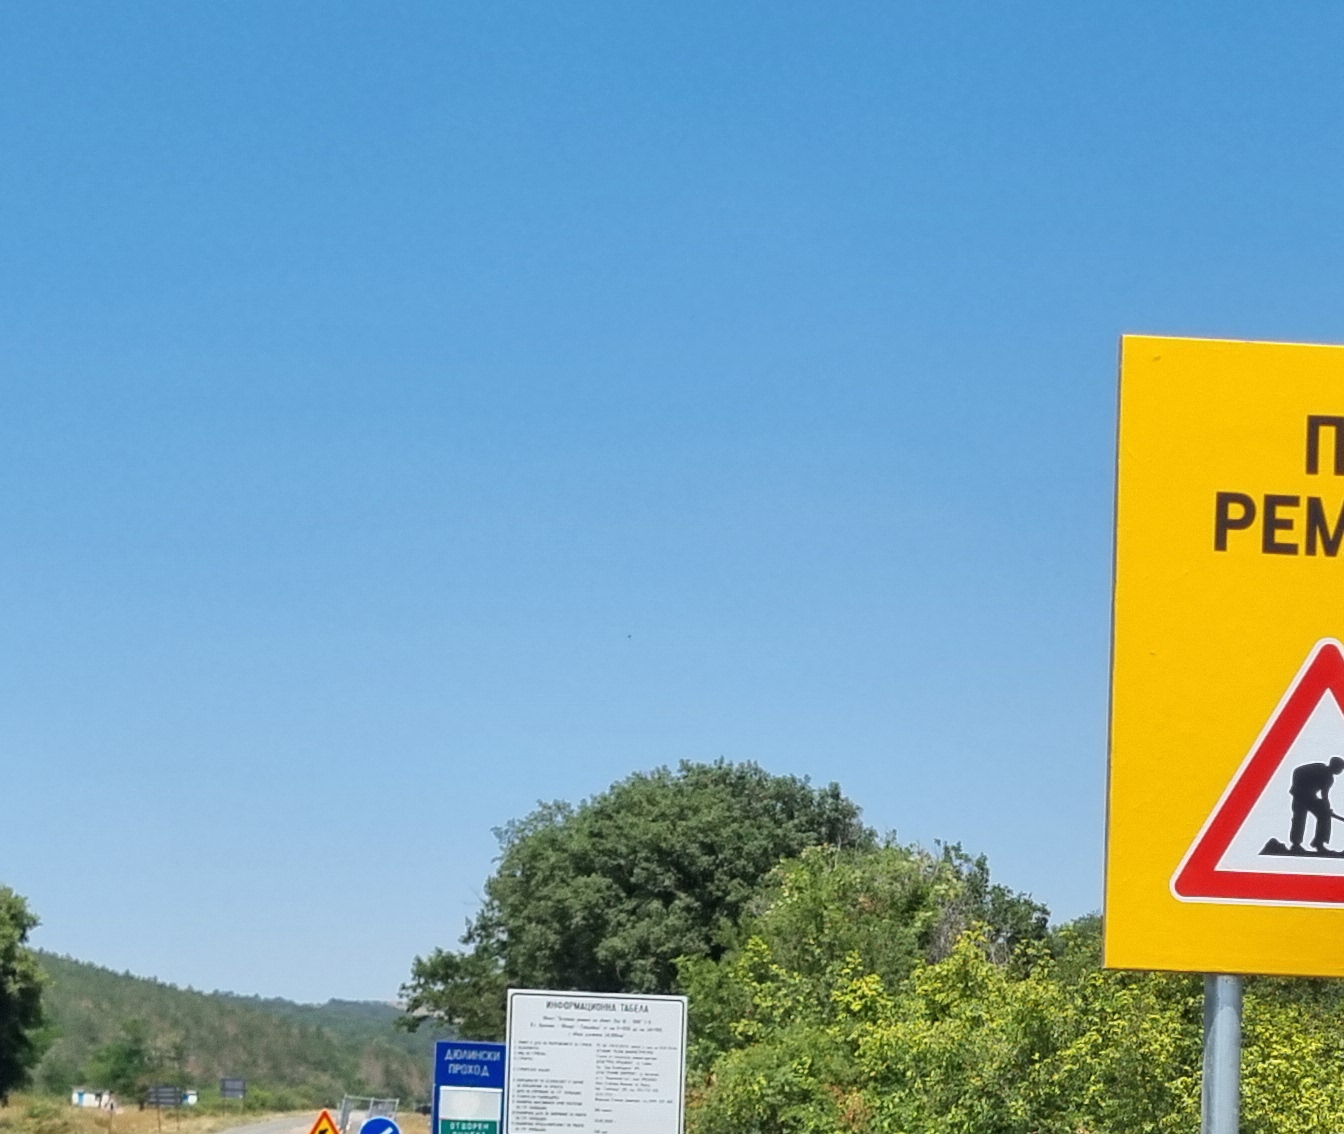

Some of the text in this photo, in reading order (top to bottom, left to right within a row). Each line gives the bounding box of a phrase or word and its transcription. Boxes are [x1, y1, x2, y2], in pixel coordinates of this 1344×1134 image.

[545, 1000, 650, 1014] ИНФОРМАЦИОННА ТАБЕЛА
[444, 1048, 501, 1062] ДЮЛИНСКИ
[448, 1063, 490, 1077] ПРОХОД
